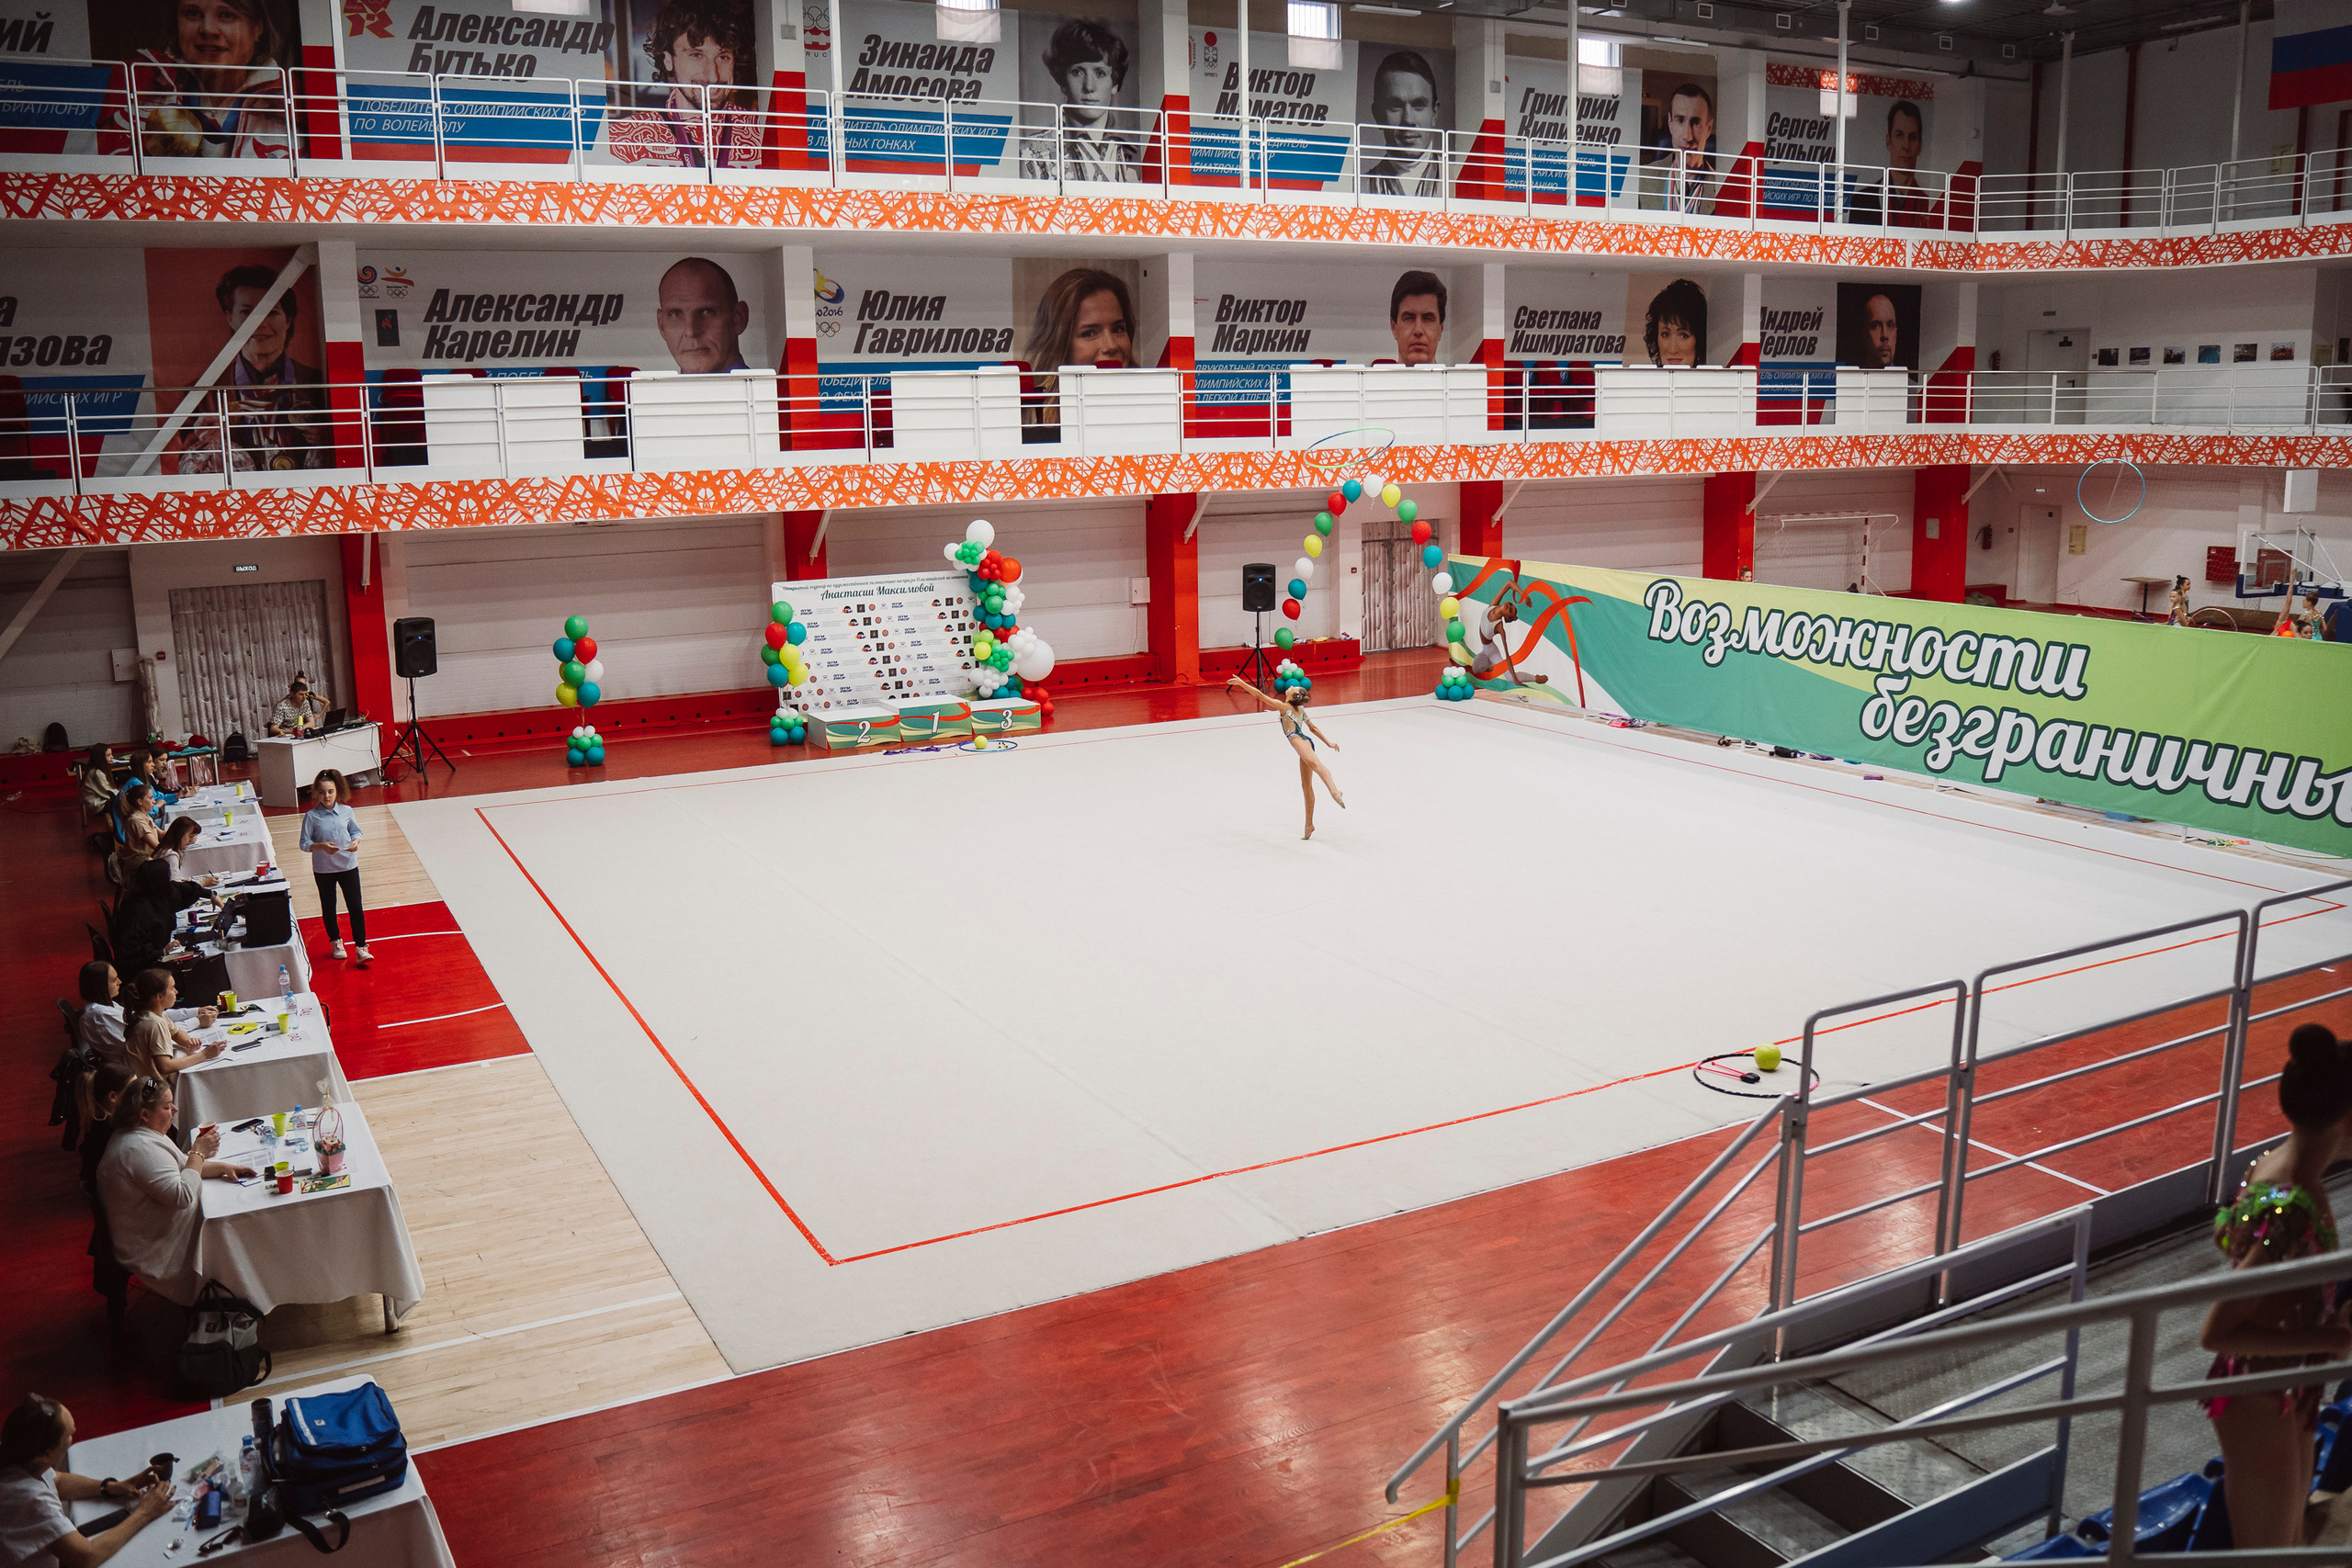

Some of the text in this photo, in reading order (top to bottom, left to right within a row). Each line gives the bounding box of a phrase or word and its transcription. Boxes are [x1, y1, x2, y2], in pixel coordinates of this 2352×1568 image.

[408, 6, 615, 54] Александр
[405, 42, 537, 83] Бутько
[858, 34, 996, 77] Зинаида
[845, 67, 983, 106] Амосова
[359, 99, 451, 114] ПОБЕДИТЕЬ
[561, 107, 587, 118] ИР
[1214, 91, 1329, 127] Мматов
[1519, 87, 1621, 122] Григрий
[354, 118, 377, 130] ПО
[978, 127, 1000, 137] ИГР
[1766, 111, 1831, 141] Сергей
[871, 138, 917, 151] ГОНКАХ
[423, 288, 625, 326] Александр
[856, 290, 947, 321] Юлия
[1215, 294, 1307, 325] Виктор
[1513, 305, 1602, 330] Светлана
[423, 324, 582, 362] Карелин
[853, 322, 1015, 356] Гаврилова
[1211, 324, 1311, 355] Маркин
[1510, 330, 1626, 355] Ишмуратова
[820, 583, 934, 601] Анастасии Максимовой
[1644, 579, 2092, 701] Возможности
[856, 720, 872, 744] 2
[931, 709, 941, 734] 1
[1001, 708, 1014, 730] 3
